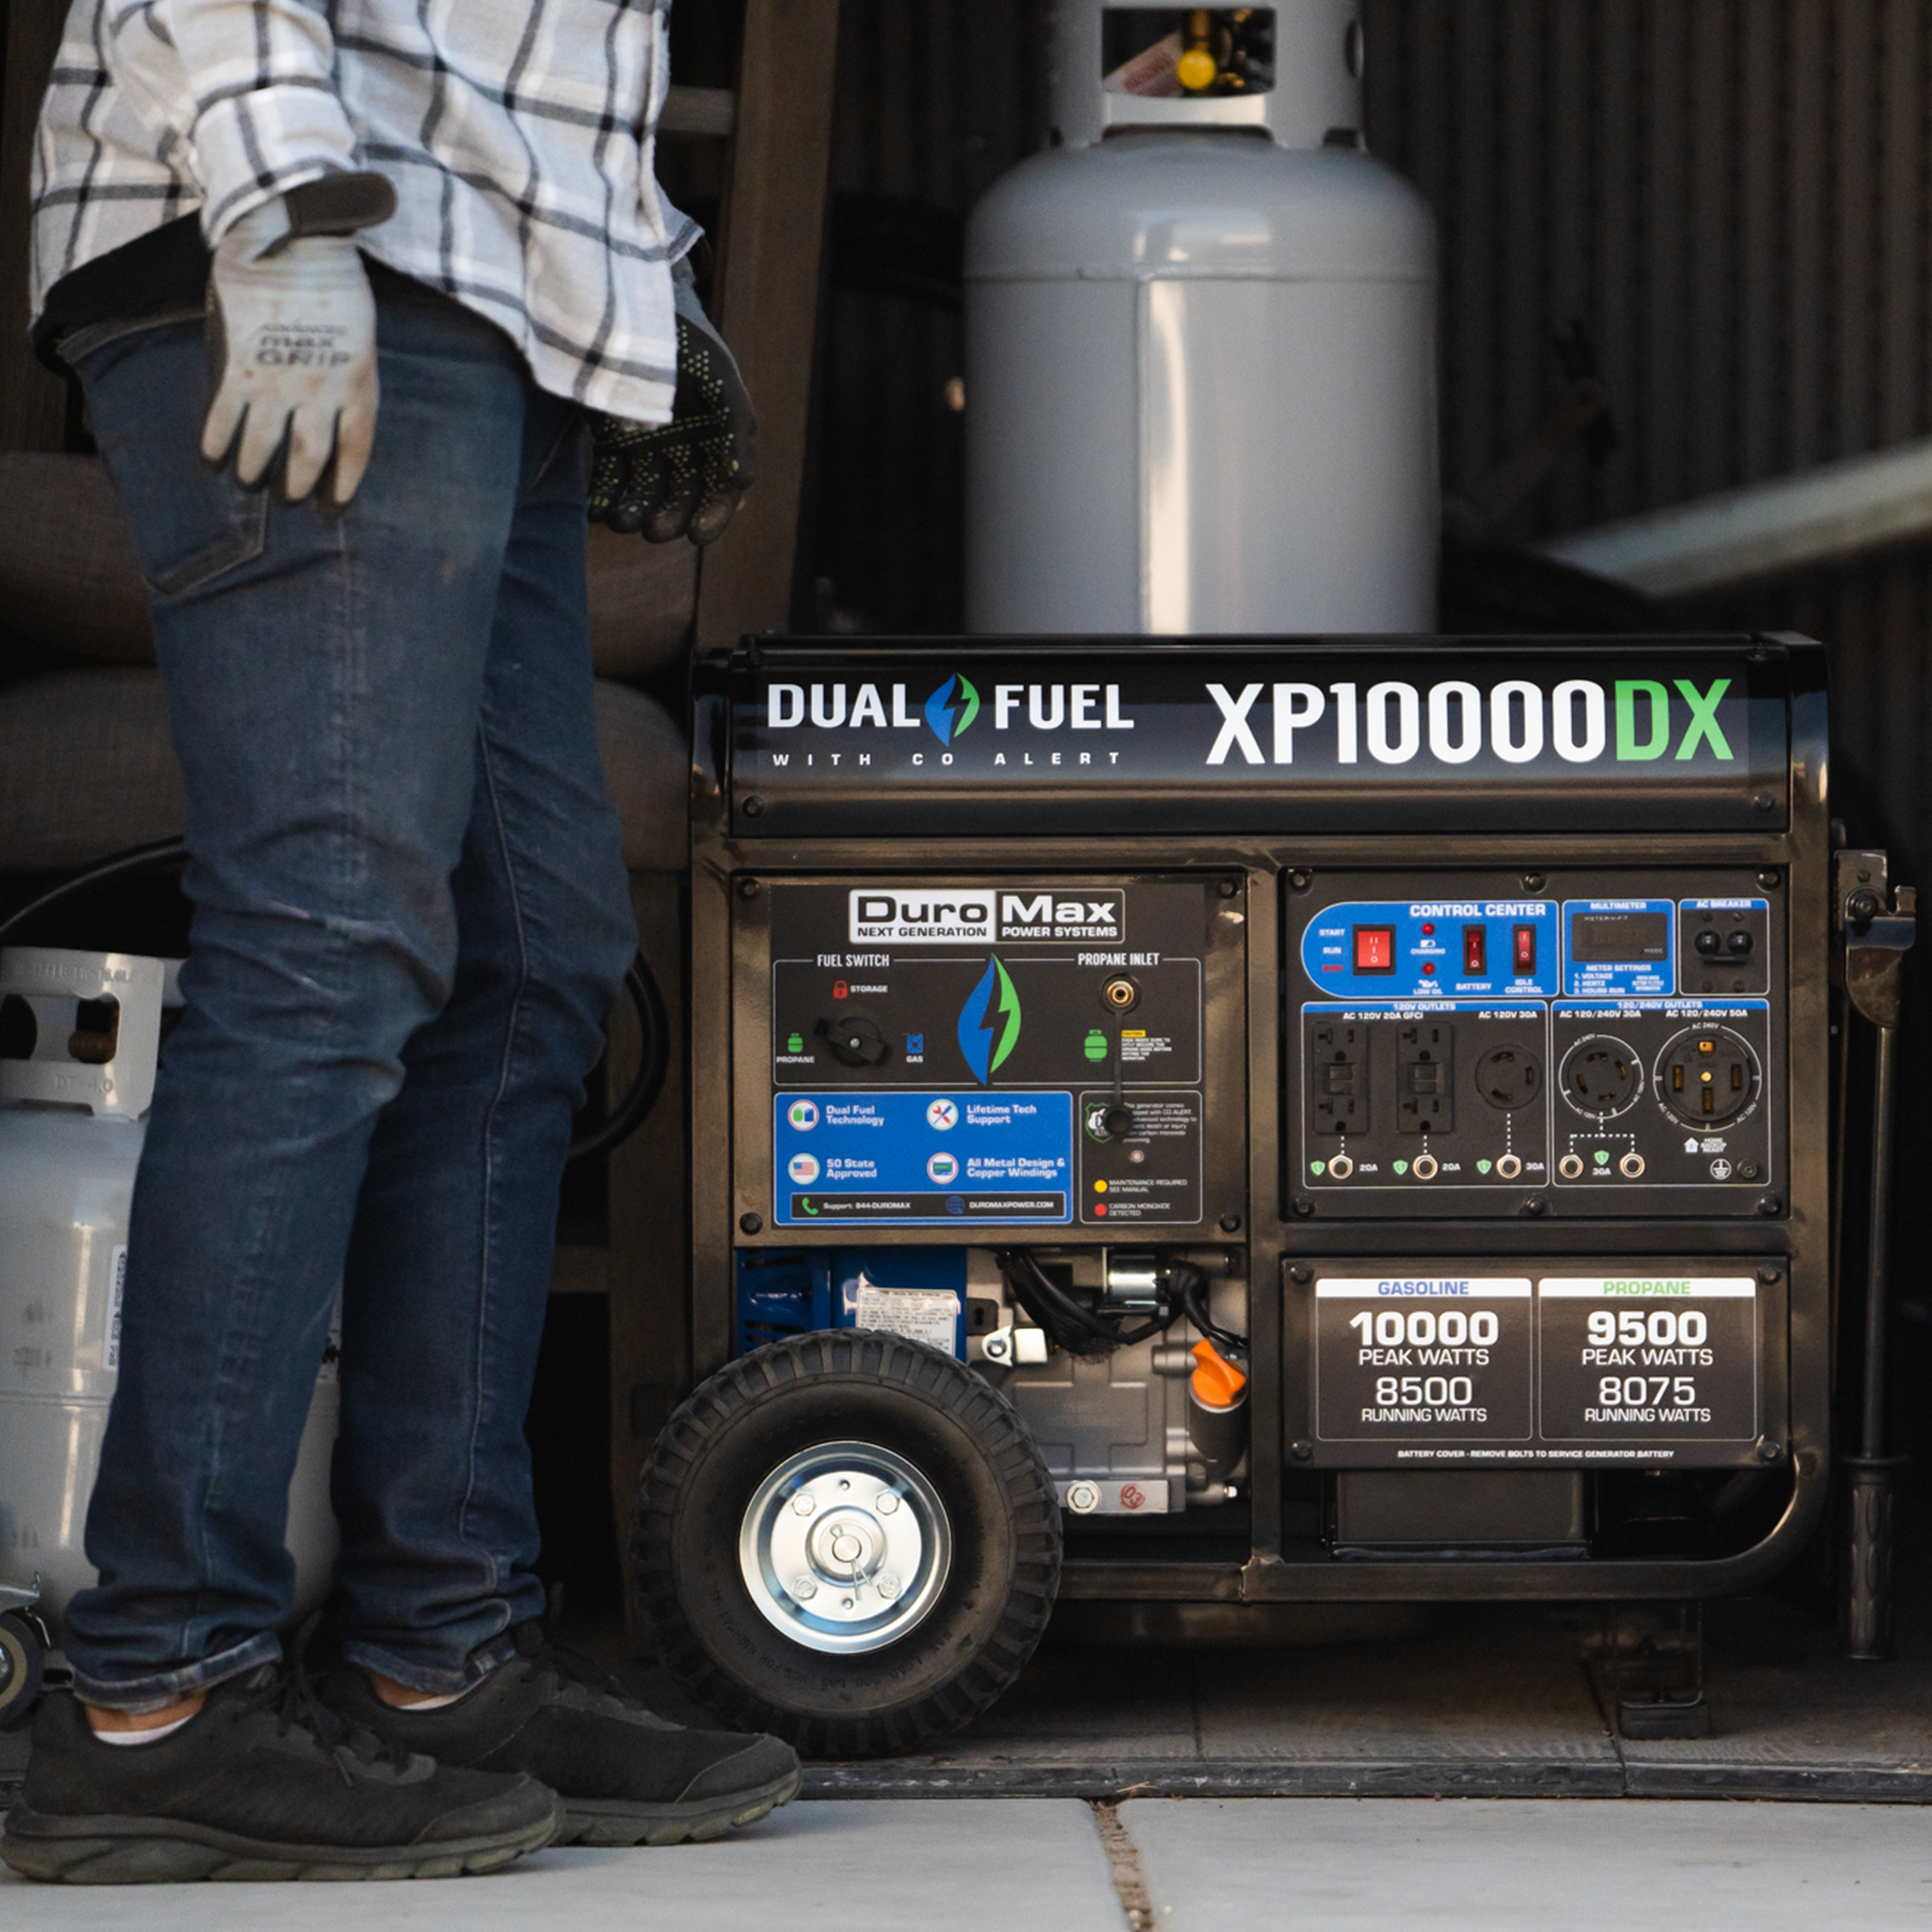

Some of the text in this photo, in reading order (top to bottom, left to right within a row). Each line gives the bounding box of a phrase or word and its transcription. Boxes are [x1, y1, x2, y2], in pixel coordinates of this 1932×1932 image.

[768, 684, 1134, 730] DUAL FUEL
[1205, 680, 1733, 764] XP10000DX
[773, 753, 1119, 765] WITH CO ALERT
[858, 896, 1115, 922] Duro Max
[1410, 904, 1546, 917] CONTROL CENTER
[858, 926, 1117, 936] NEXT GENERATION POWER SYSTEMS
[817, 954, 889, 967] FUEL SWITCH
[1078, 953, 1160, 965] PROPANE INLET
[826, 1104, 876, 1115] Dual Fuel
[966, 1104, 1037, 1114] Lifetime Tech
[826, 1115, 885, 1127] Technology
[966, 1115, 1012, 1126] Support
[826, 1159, 876, 1169] 50 State
[966, 1158, 1066, 1169] All Metal Design &
[826, 1169, 878, 1179] Approved
[966, 1168, 1058, 1178] Copper Windings
[823, 1201, 911, 1210] Support: 844-DUROMAX
[1378, 1281, 1469, 1296] GASOLINE
[1602, 1281, 1691, 1296] PROPANE
[1350, 1311, 1498, 1345] 10000
[1588, 1311, 1707, 1345] 9500
[1359, 1349, 1489, 1365] PEAK WATTS
[1583, 1349, 1713, 1365] PEAK WATTS
[1377, 1377, 1471, 1405] 8500
[1599, 1377, 1695, 1405] 8075
[1361, 1408, 1488, 1423] RUNNING WATTS
[1585, 1408, 1712, 1423] RUNNING WATTS
[1124, 1485, 1144, 1506] 03
